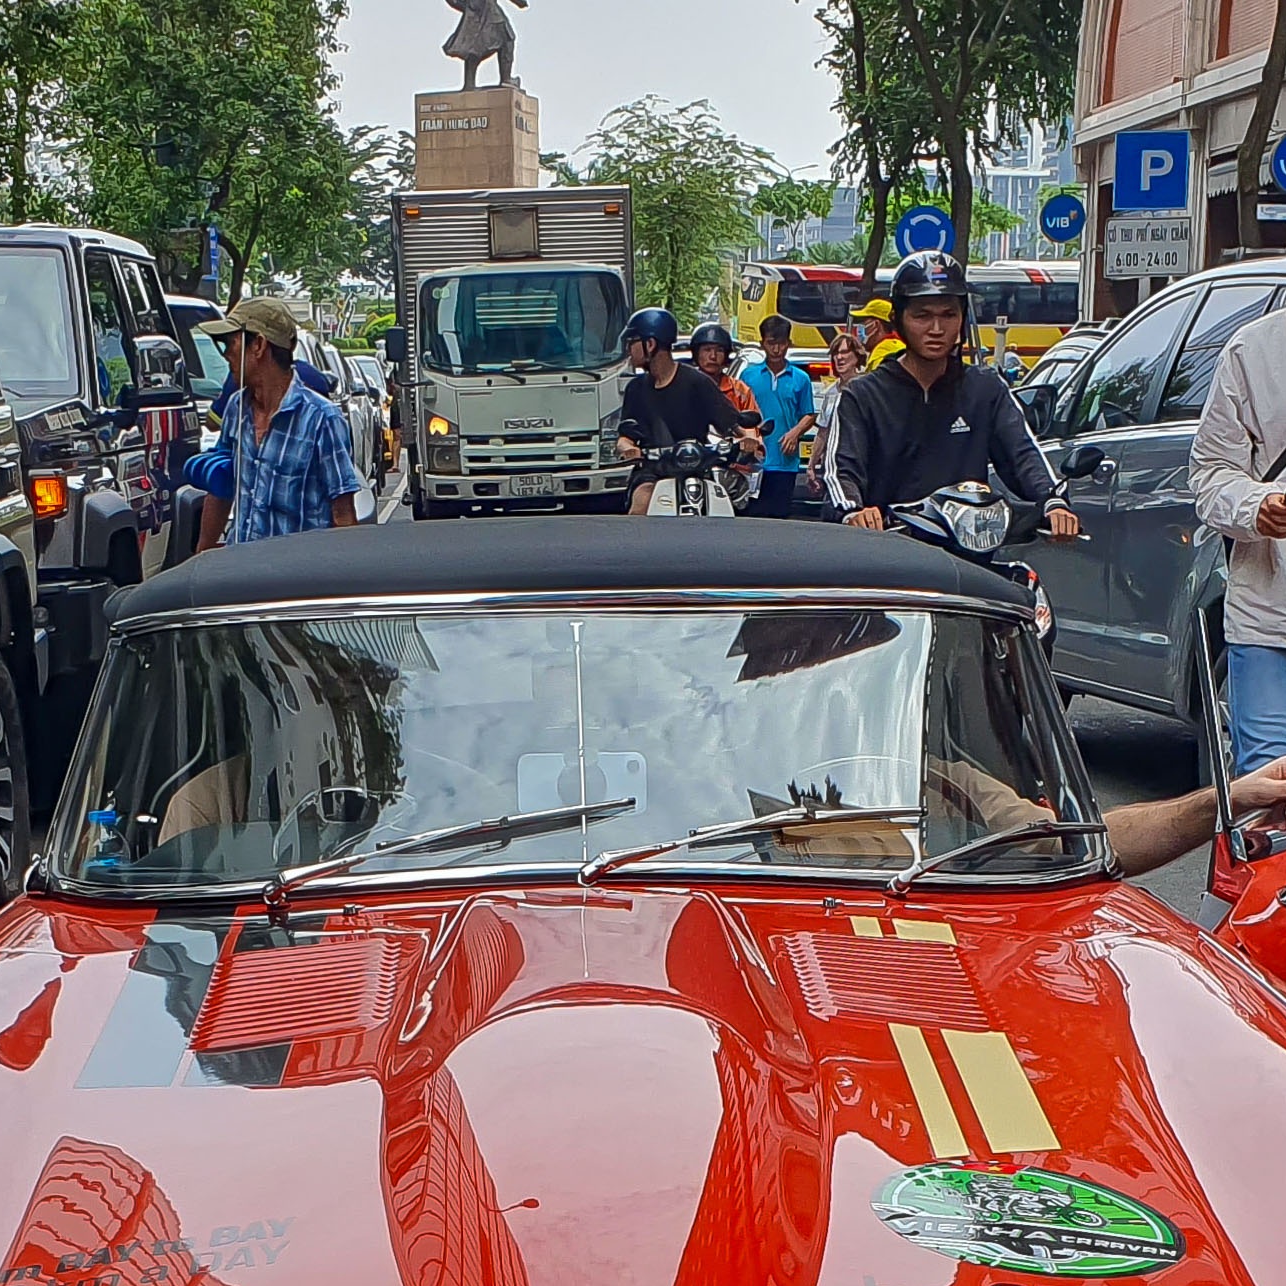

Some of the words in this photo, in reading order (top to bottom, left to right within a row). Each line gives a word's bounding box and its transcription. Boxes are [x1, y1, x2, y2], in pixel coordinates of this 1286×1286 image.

[1140, 149, 1174, 191] P
[1046, 216, 1070, 228] VIB
[503, 417, 554, 430] ISUZU
[55, 1239, 144, 1274] BAY
[152, 1237, 195, 1256] to
[210, 1216, 298, 1248] BAY
[1060, 1234, 1177, 1258] CARAVAN
[140, 1265, 170, 1284] a
[188, 1241, 291, 1276] DAY
